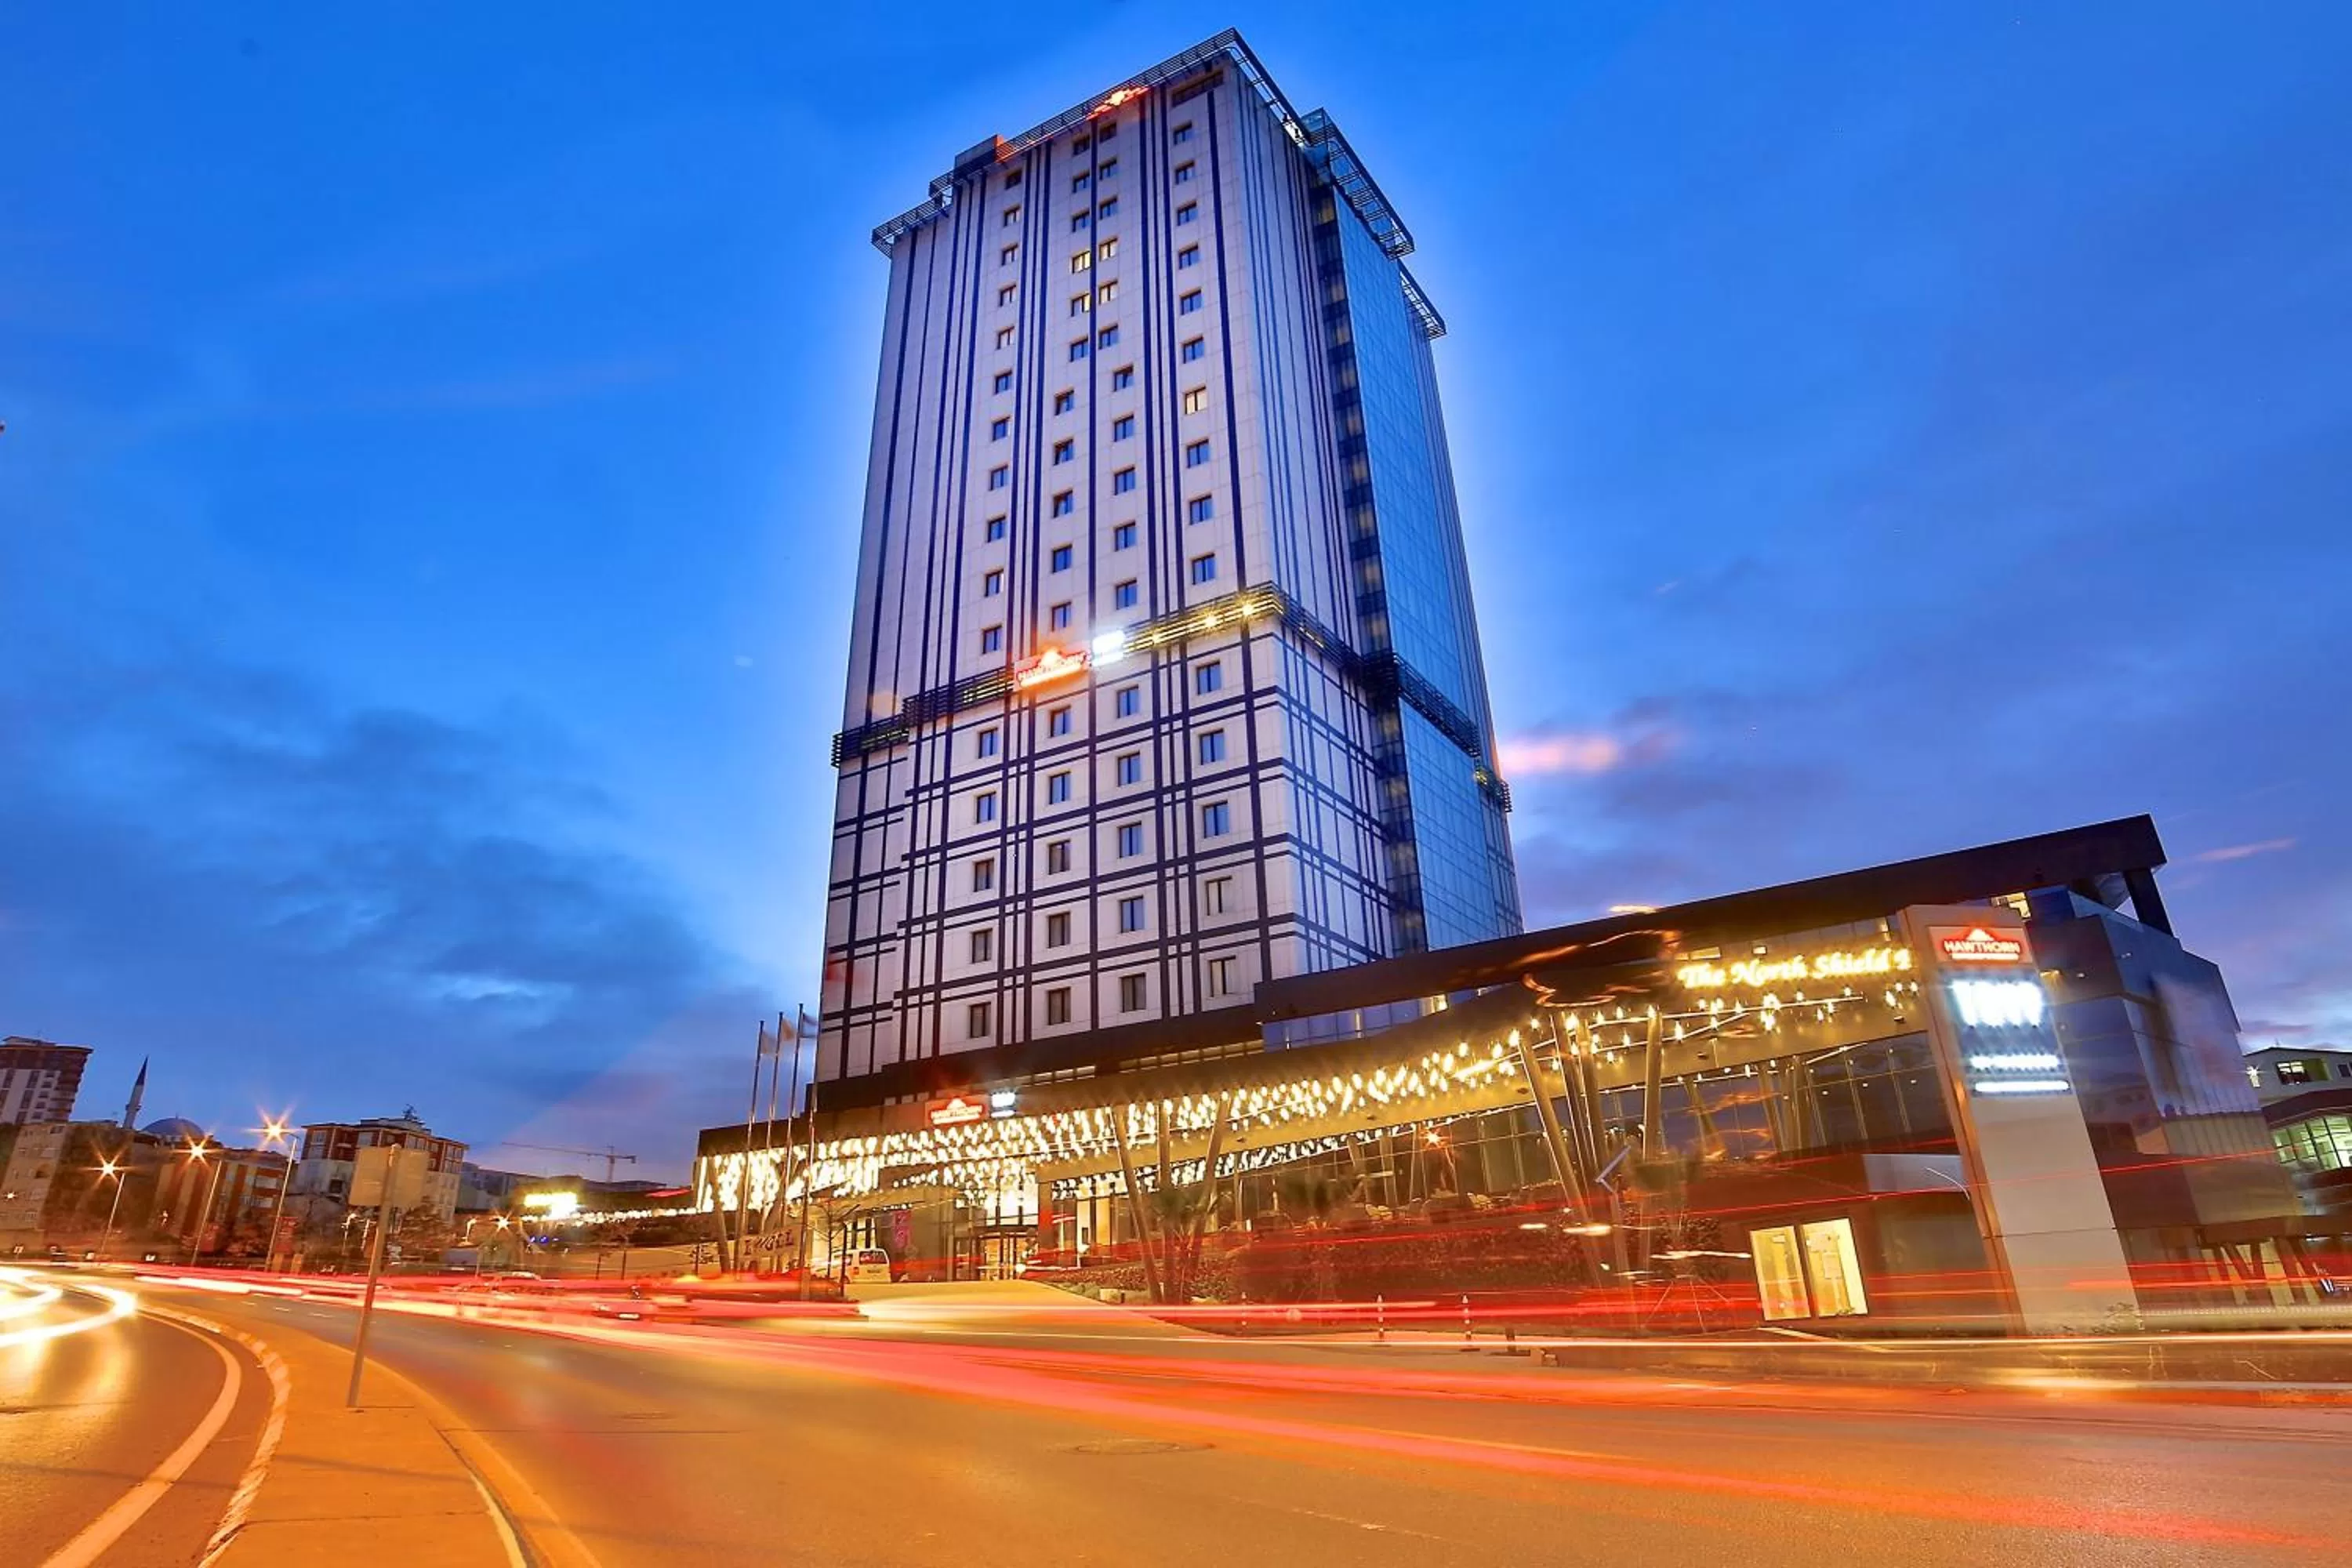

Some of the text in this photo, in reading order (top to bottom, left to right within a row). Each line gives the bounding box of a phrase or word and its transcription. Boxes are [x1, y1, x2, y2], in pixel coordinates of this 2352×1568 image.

[1944, 940, 2020, 953] HAWTHORN
[1678, 947, 1891, 989] The North Shield
